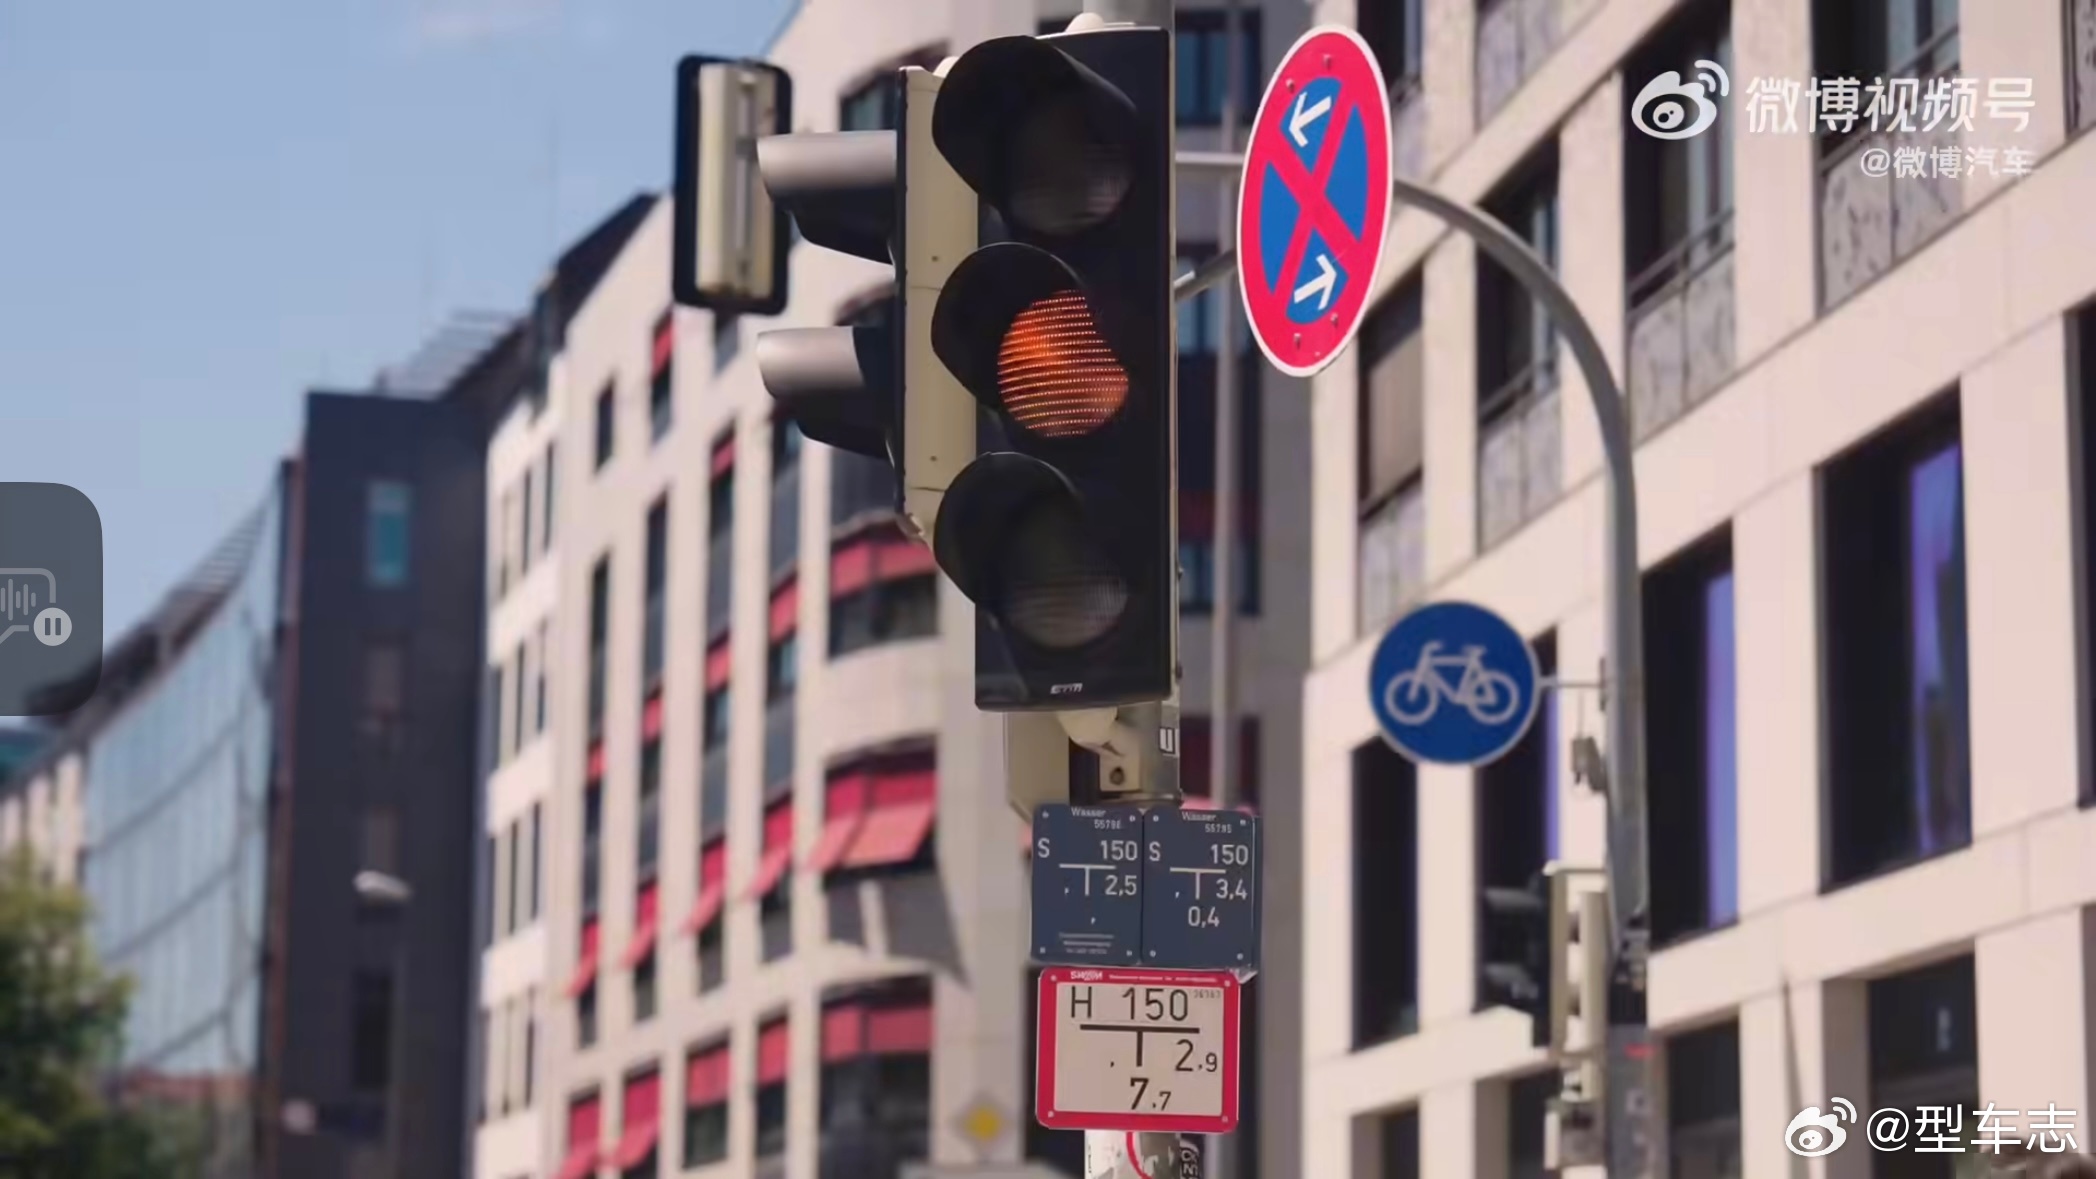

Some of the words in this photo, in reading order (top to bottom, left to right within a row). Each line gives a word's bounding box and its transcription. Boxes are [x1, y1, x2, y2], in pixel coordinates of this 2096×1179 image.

[1071, 806, 1106, 818] Wasser
[1182, 811, 1217, 822] Wasser
[1037, 837, 1051, 859] S
[1100, 840, 1139, 861] 150
[1149, 841, 1161, 862] S
[1210, 844, 1249, 865] 150
[1104, 875, 1138, 897] 2,5
[1215, 878, 1248, 901] 3,4
[1187, 906, 1220, 928] 0,4
[1071, 986, 1093, 1019] H
[1122, 987, 1189, 1022] 150
